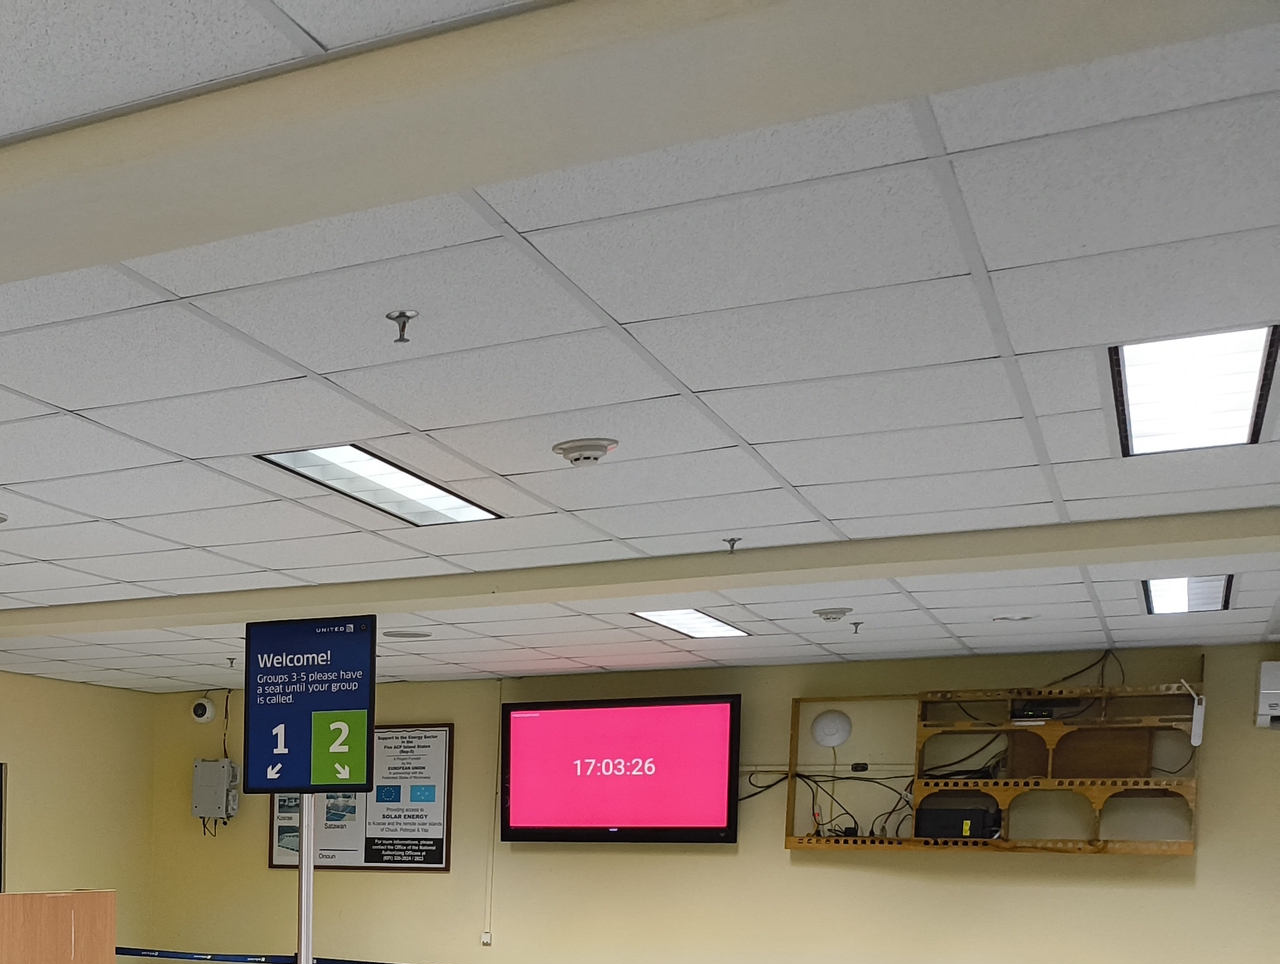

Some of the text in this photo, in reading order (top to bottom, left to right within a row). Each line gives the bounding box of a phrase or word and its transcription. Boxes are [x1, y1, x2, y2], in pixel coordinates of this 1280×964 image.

[257, 650, 331, 668] Welcome!
[257, 670, 363, 684] Groups 3-5 please have
[257, 681, 359, 694] a seat until your group
[257, 694, 294, 704] is called.
[272, 723, 289, 755] 1
[328, 721, 350, 753] 2
[573, 757, 656, 776] 17:03:26
